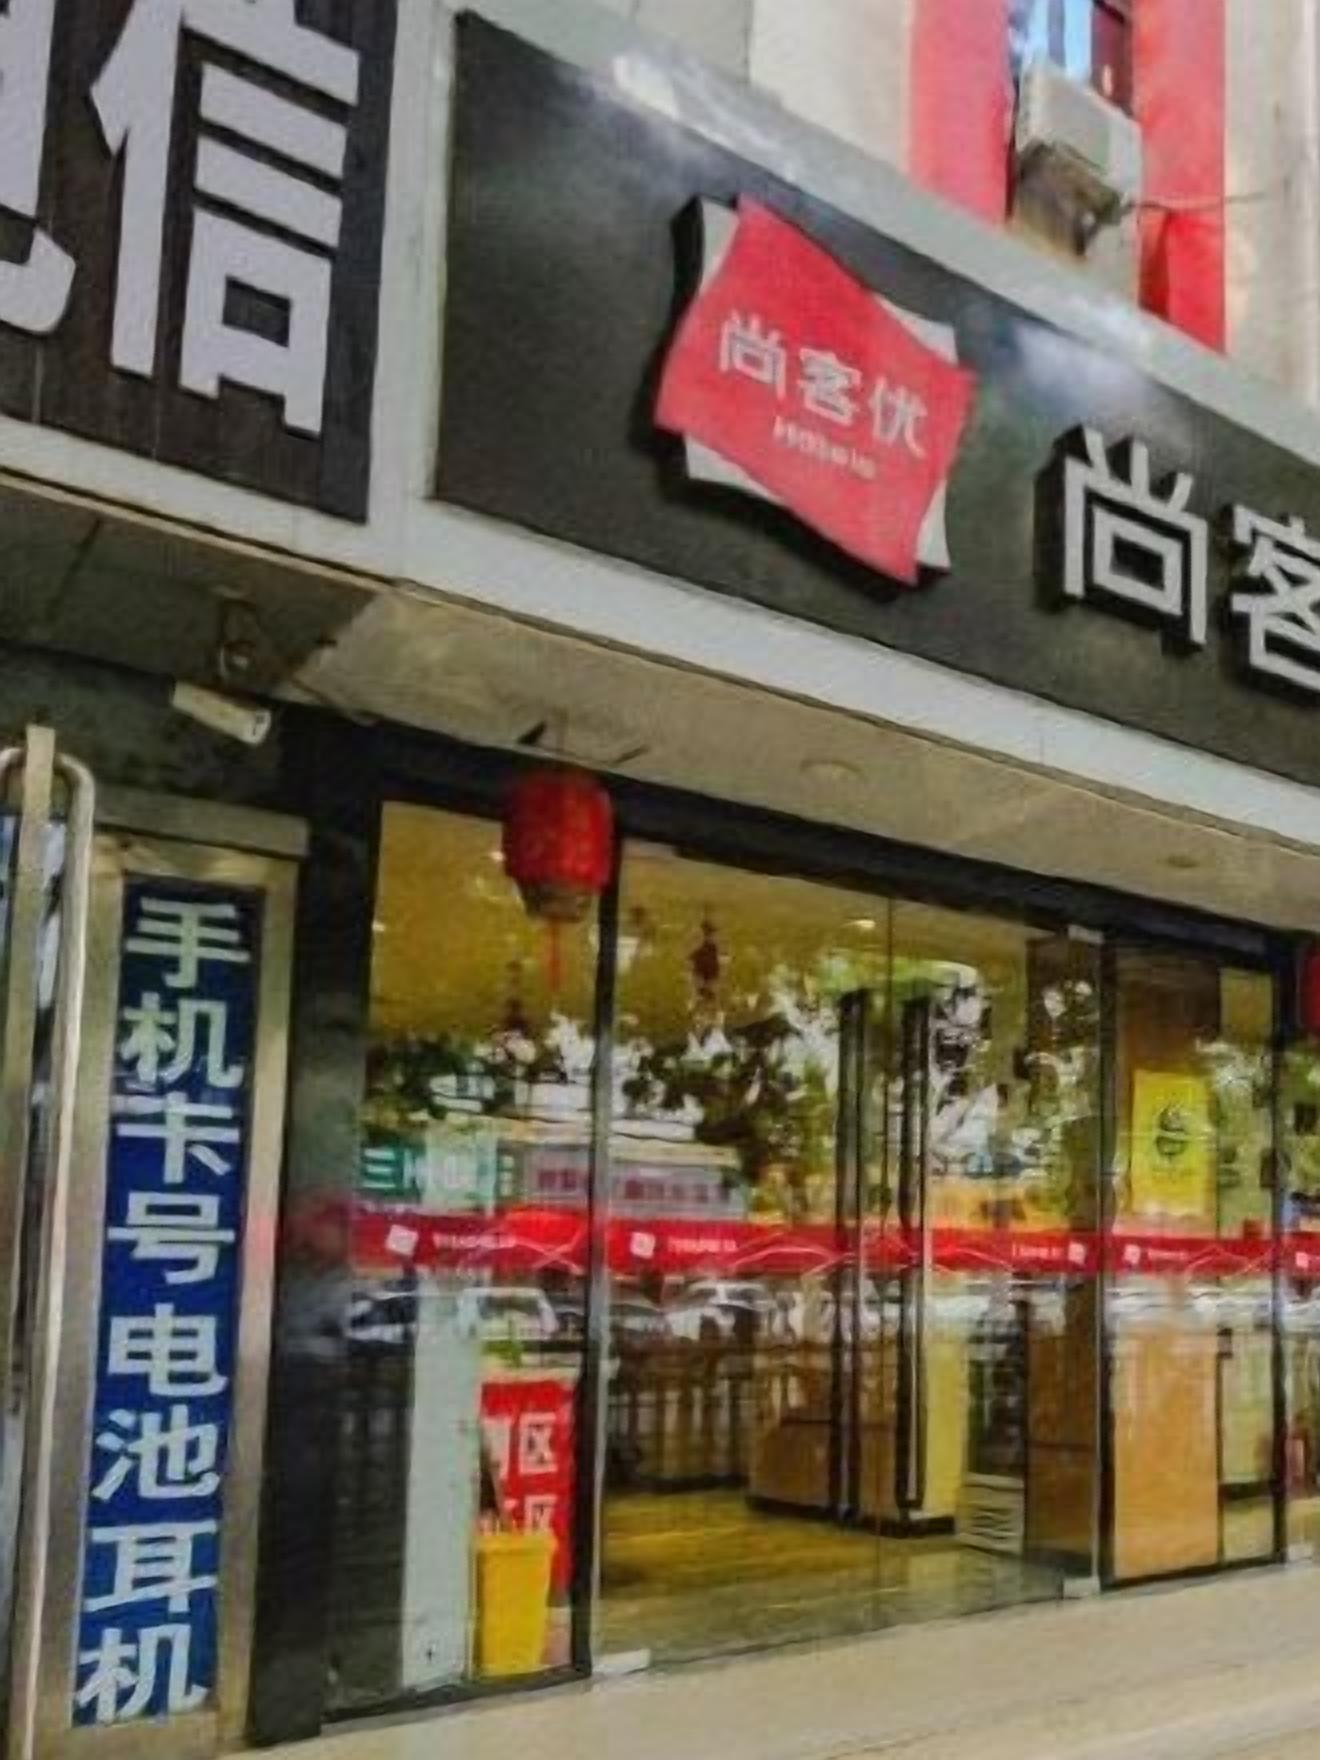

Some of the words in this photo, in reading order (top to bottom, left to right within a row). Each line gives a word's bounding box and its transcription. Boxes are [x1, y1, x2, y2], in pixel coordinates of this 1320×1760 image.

[0, 0, 360, 436] 信
[718, 308, 927, 459] 尚客优
[76, 896, 251, 1725] 手机卡号电池耳机
